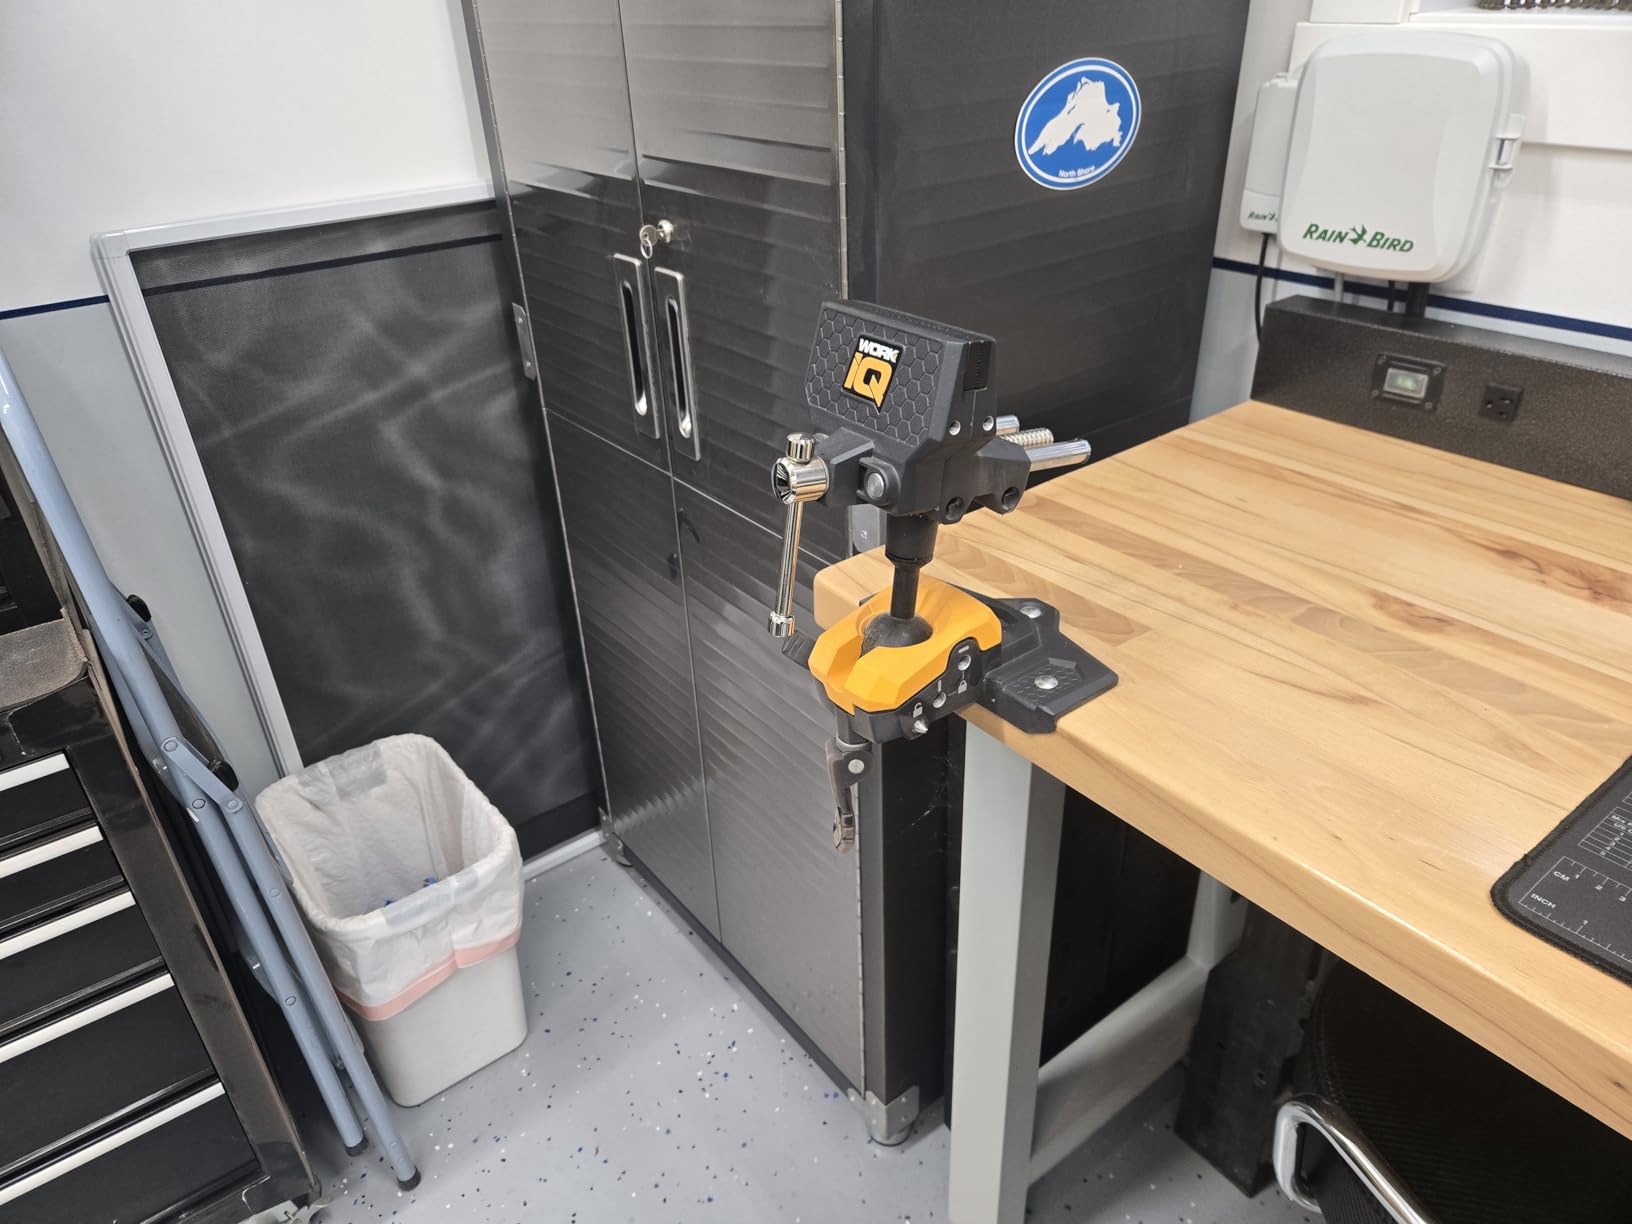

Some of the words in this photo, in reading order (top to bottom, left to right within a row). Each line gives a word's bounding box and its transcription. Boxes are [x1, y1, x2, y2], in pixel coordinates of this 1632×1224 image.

[1303, 223, 1349, 243] RAIN
[1367, 231, 1414, 253] BIRD
[858, 338, 899, 363] WORK
[1553, 871, 1570, 881] CM
[1531, 893, 1557, 909] INCH
